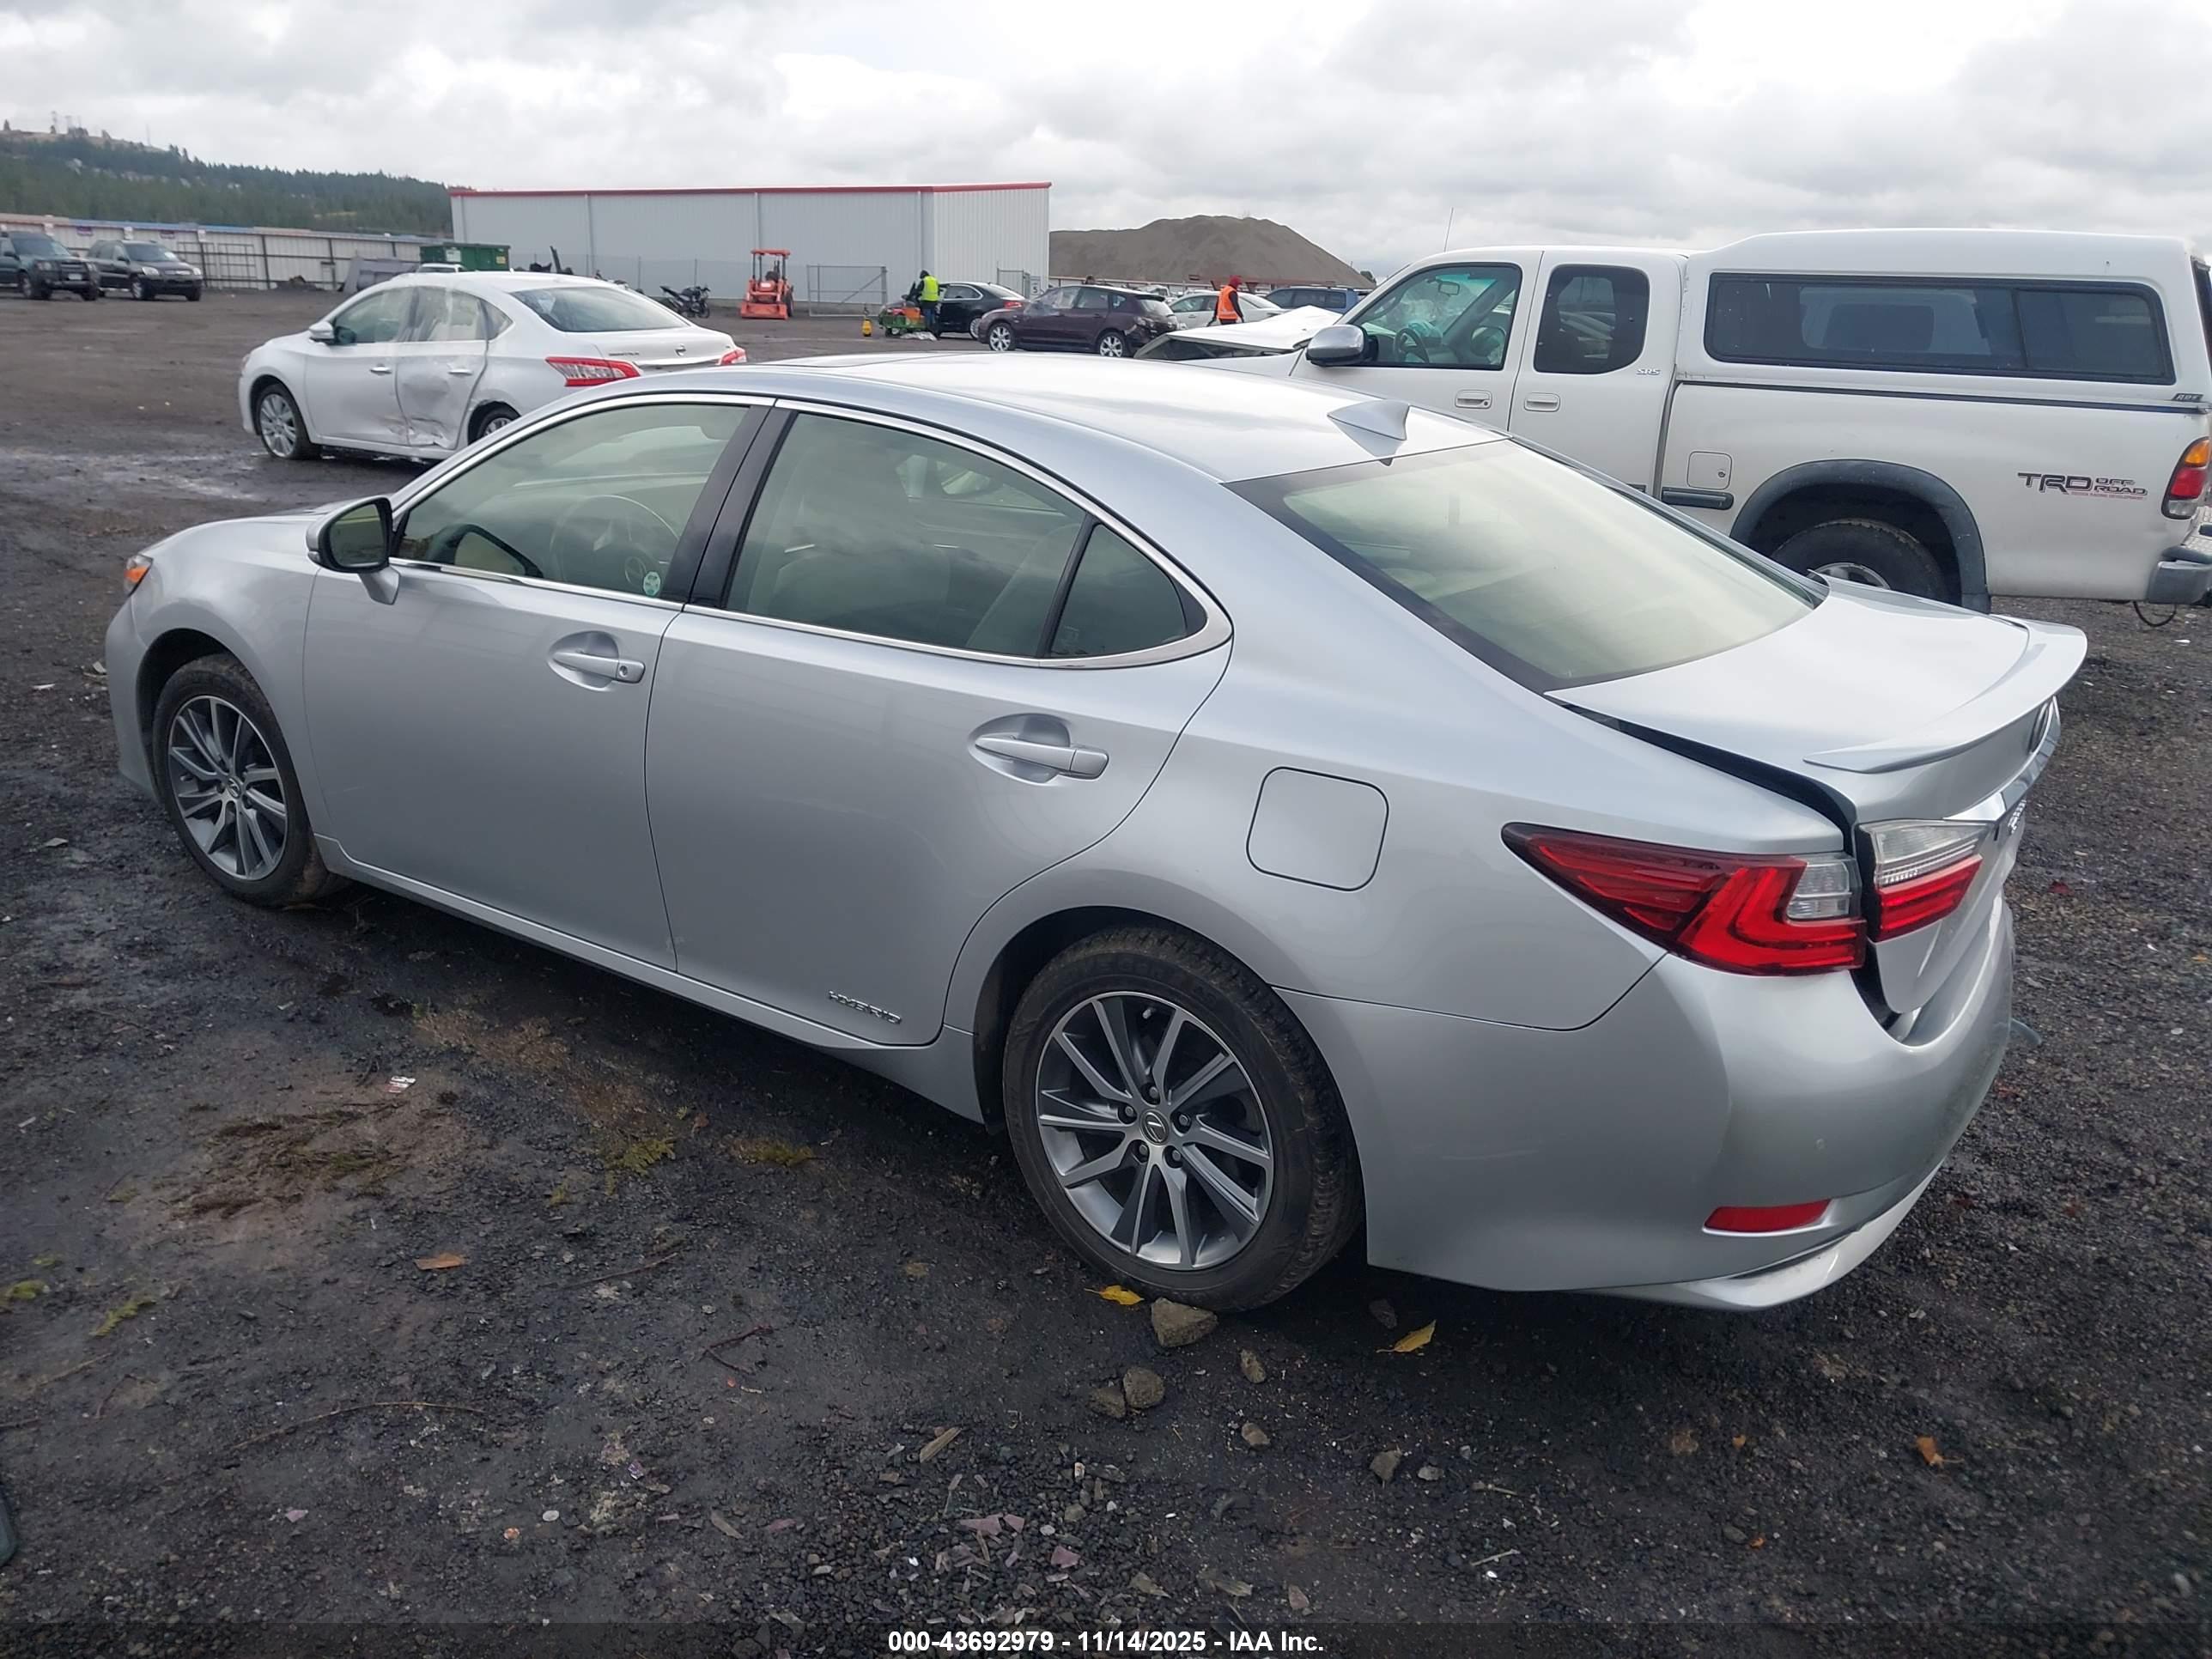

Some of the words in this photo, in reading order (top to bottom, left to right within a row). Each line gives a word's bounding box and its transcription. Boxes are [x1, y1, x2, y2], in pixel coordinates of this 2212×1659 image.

[2017, 472, 2093, 495] TRD
[2095, 477, 2136, 486] OFF
[2094, 485, 2148, 496] ROAD
[829, 990, 902, 1024] HYBRID
